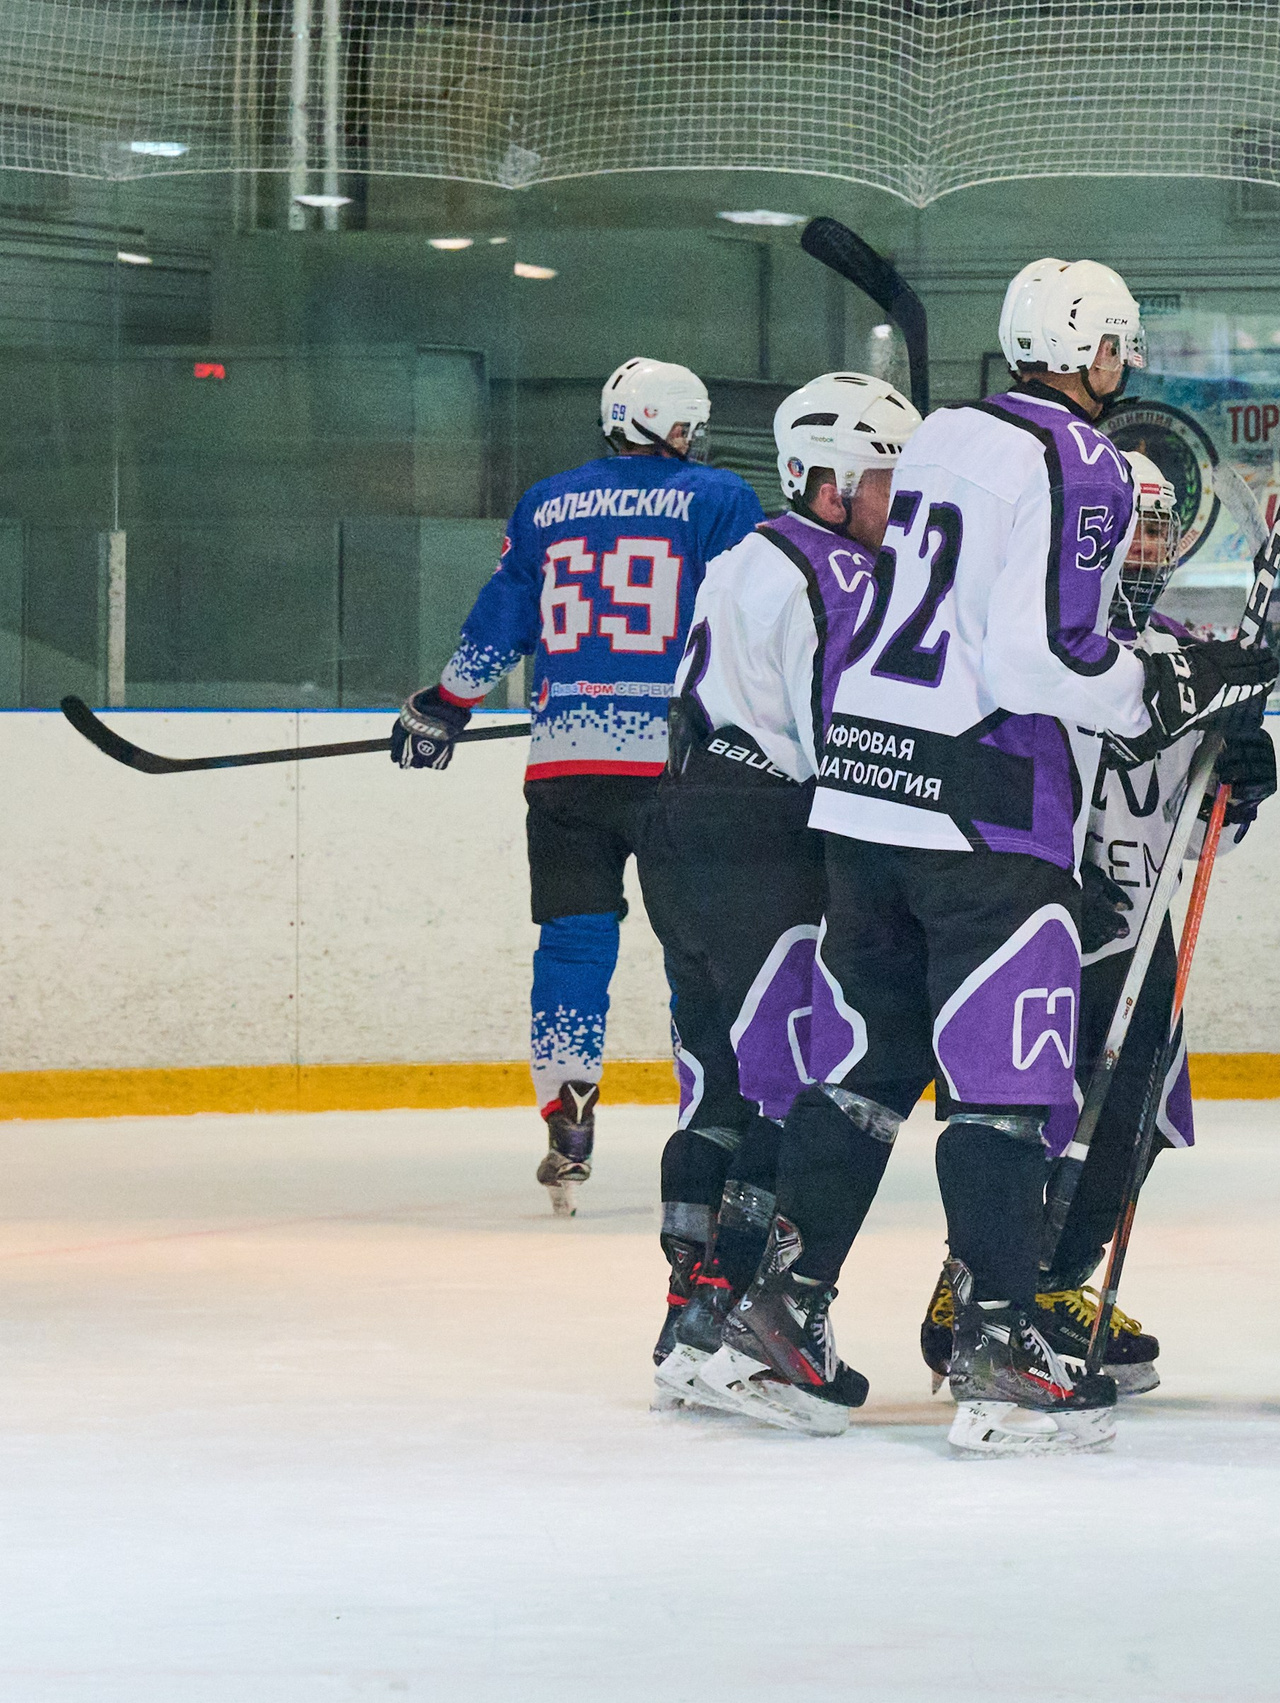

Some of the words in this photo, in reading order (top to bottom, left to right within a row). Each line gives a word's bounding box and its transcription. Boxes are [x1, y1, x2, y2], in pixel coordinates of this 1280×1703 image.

[1105, 318, 1128, 326] CCM
[611, 402, 627, 422] 69
[539, 535, 683, 656] 69
